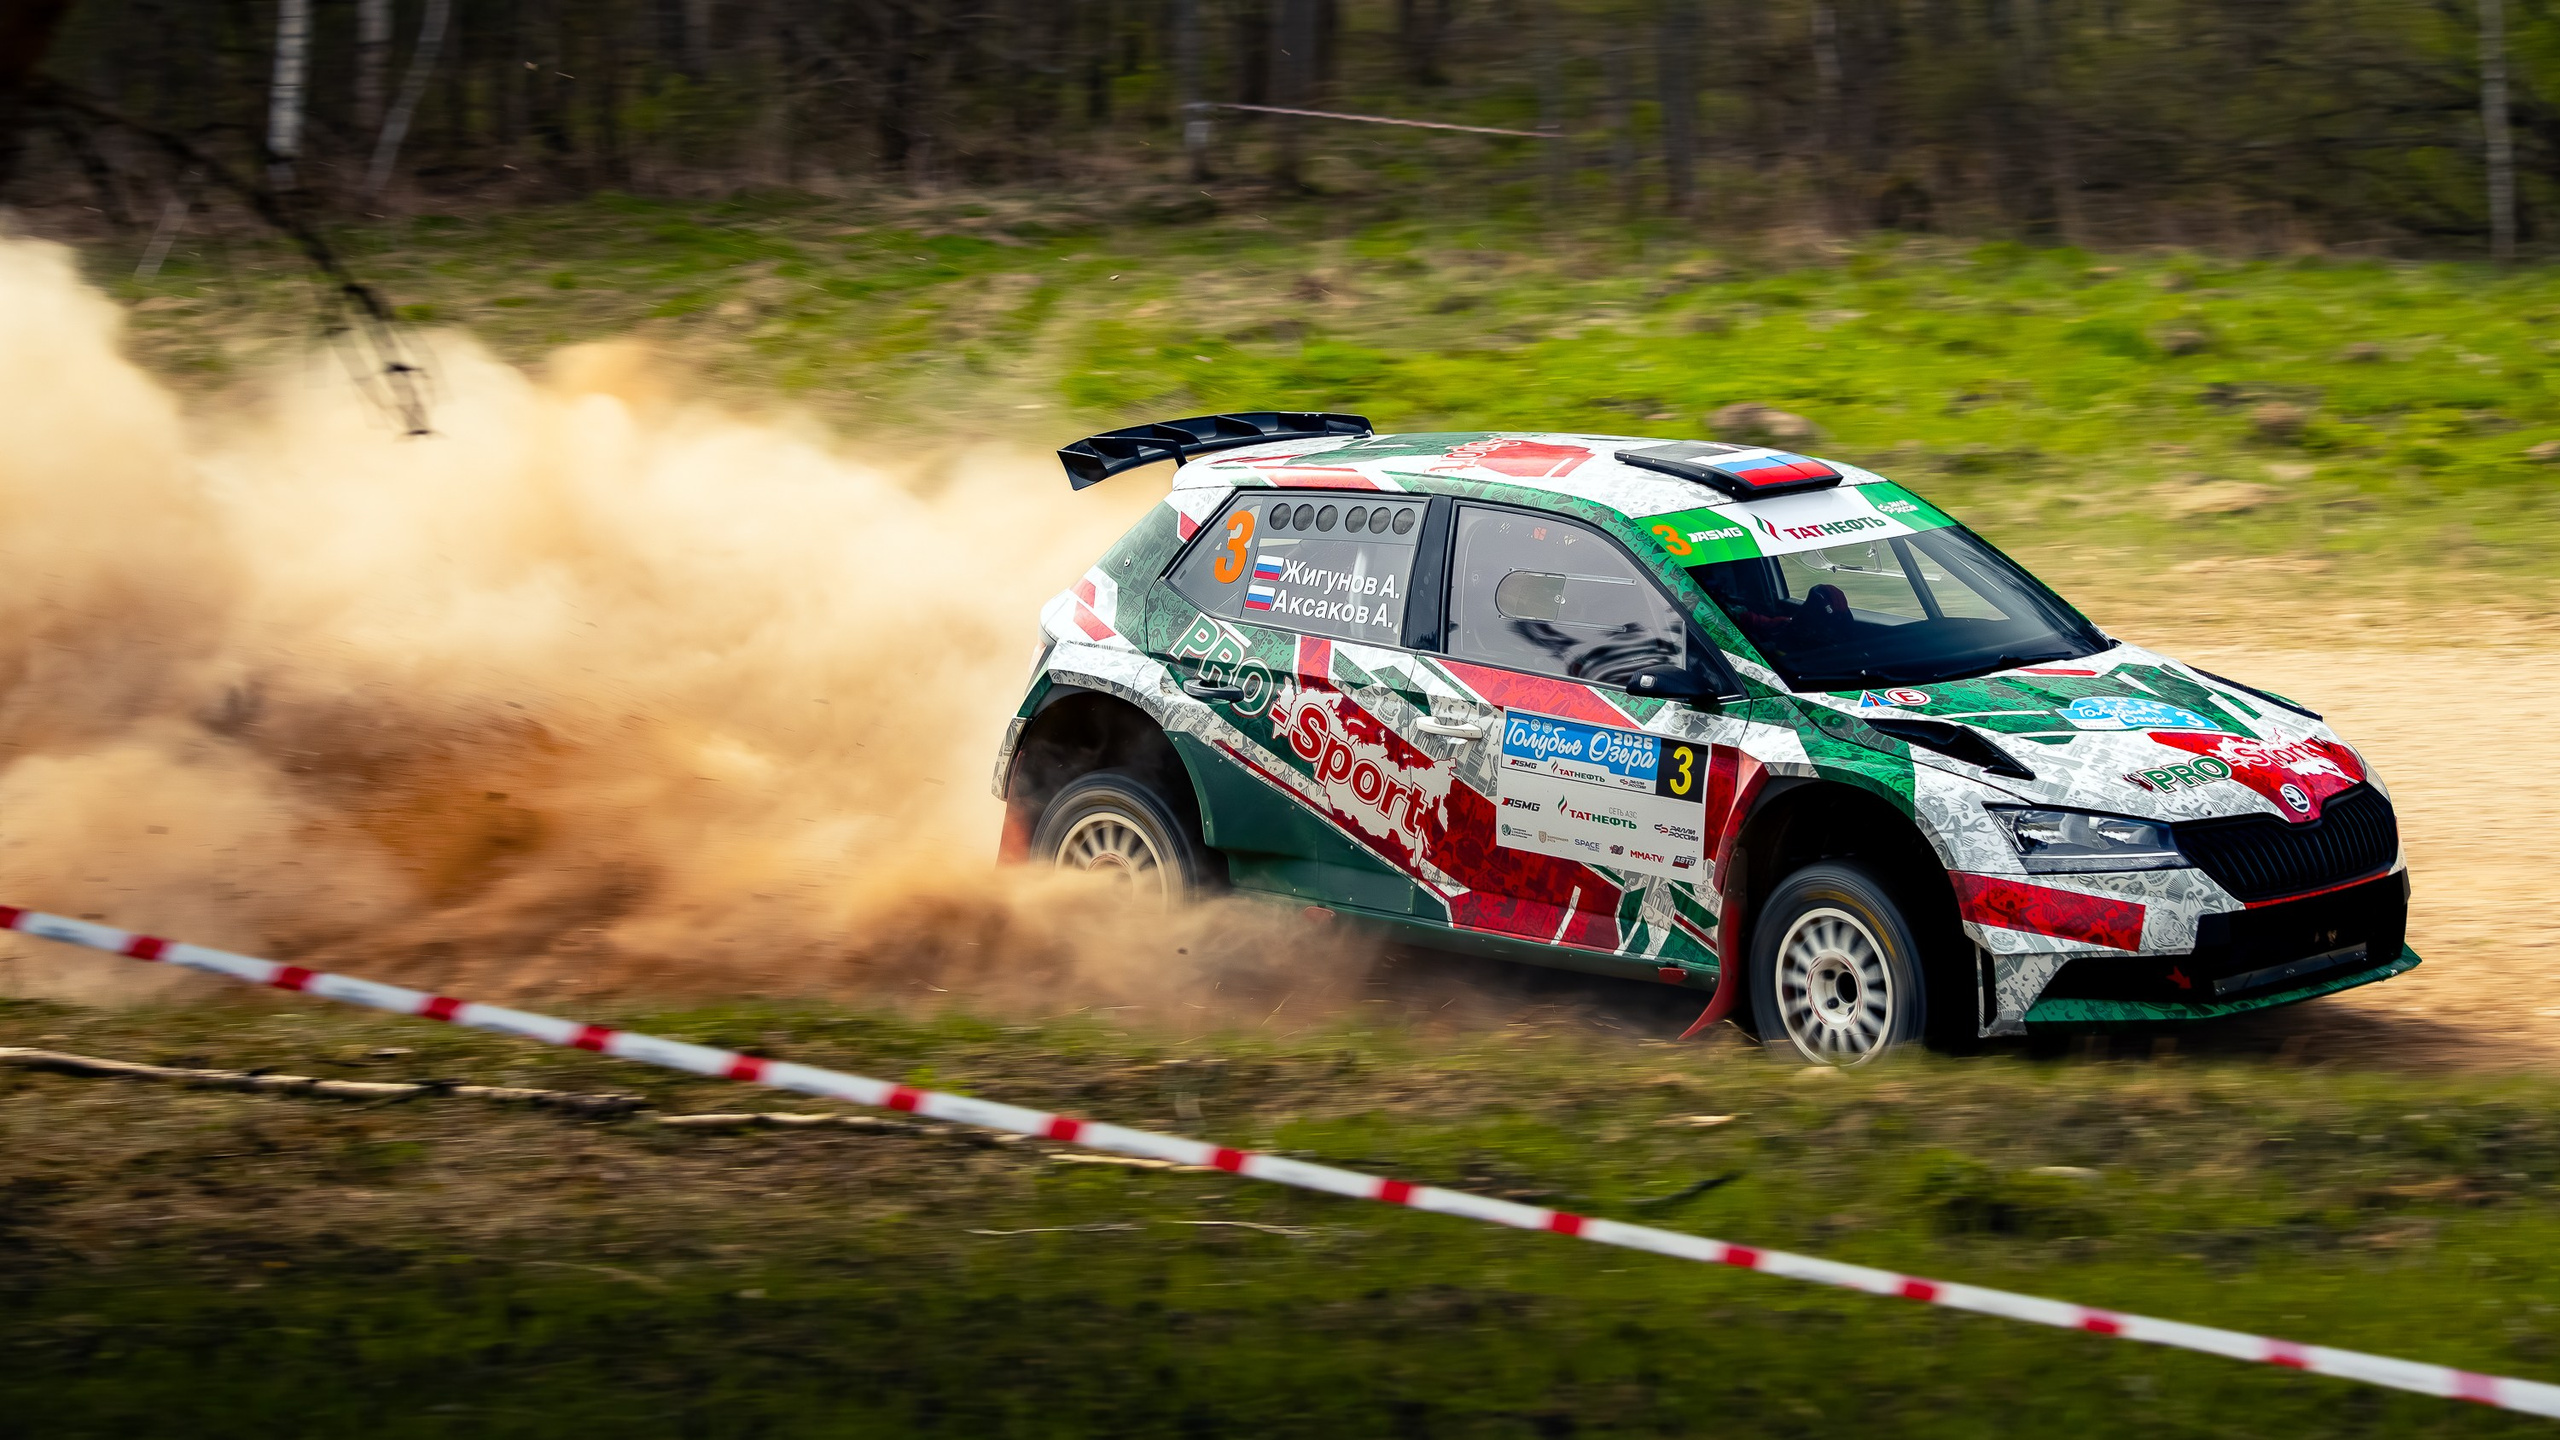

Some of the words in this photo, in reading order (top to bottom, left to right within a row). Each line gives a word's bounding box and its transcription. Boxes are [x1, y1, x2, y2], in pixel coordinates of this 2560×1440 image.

[1782, 516, 1887, 540] ТАТНЕФТЬ
[1214, 510, 1255, 583] 3
[1651, 524, 1693, 556] 3
[1279, 558, 1378, 596] Жигунов
[1378, 574, 1400, 599] А.
[1271, 589, 1369, 624] Аксаков
[1372, 602, 1394, 627] А.
[1895, 691, 1920, 702] E
[2175, 711, 2205, 727] 3
[1505, 718, 1583, 759] Голубые
[1588, 731, 1657, 775] Озера
[1613, 732, 1654, 750] 2026
[1558, 768, 1606, 783] ТАТНЕФТЬ
[1669, 746, 1694, 795] 3
[1569, 809, 1638, 830] ТАТНЕФТЬ
[1608, 806, 1624, 817] СЕТЬ
[1625, 810, 1638, 819] АЗС
[1574, 838, 1600, 850] SPACE
